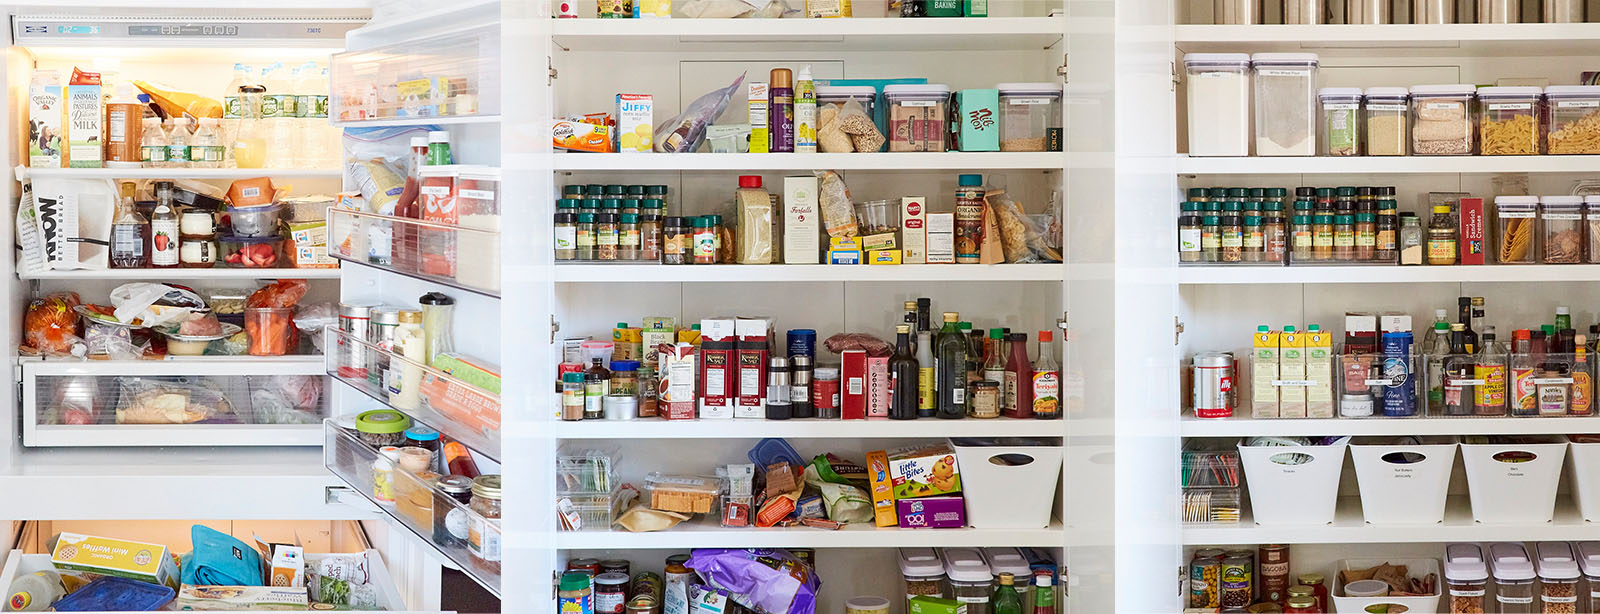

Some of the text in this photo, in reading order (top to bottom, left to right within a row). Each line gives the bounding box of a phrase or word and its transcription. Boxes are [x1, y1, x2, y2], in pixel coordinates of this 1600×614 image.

[32, 95, 57, 103] ORGANIC
[622, 102, 651, 111] JIFFY
[73, 121, 98, 130] MILK
[38, 197, 57, 263] KNOW
[899, 460, 917, 475] Little
[905, 466, 924, 480] Bites
[82, 543, 129, 556] Mini Waffles
